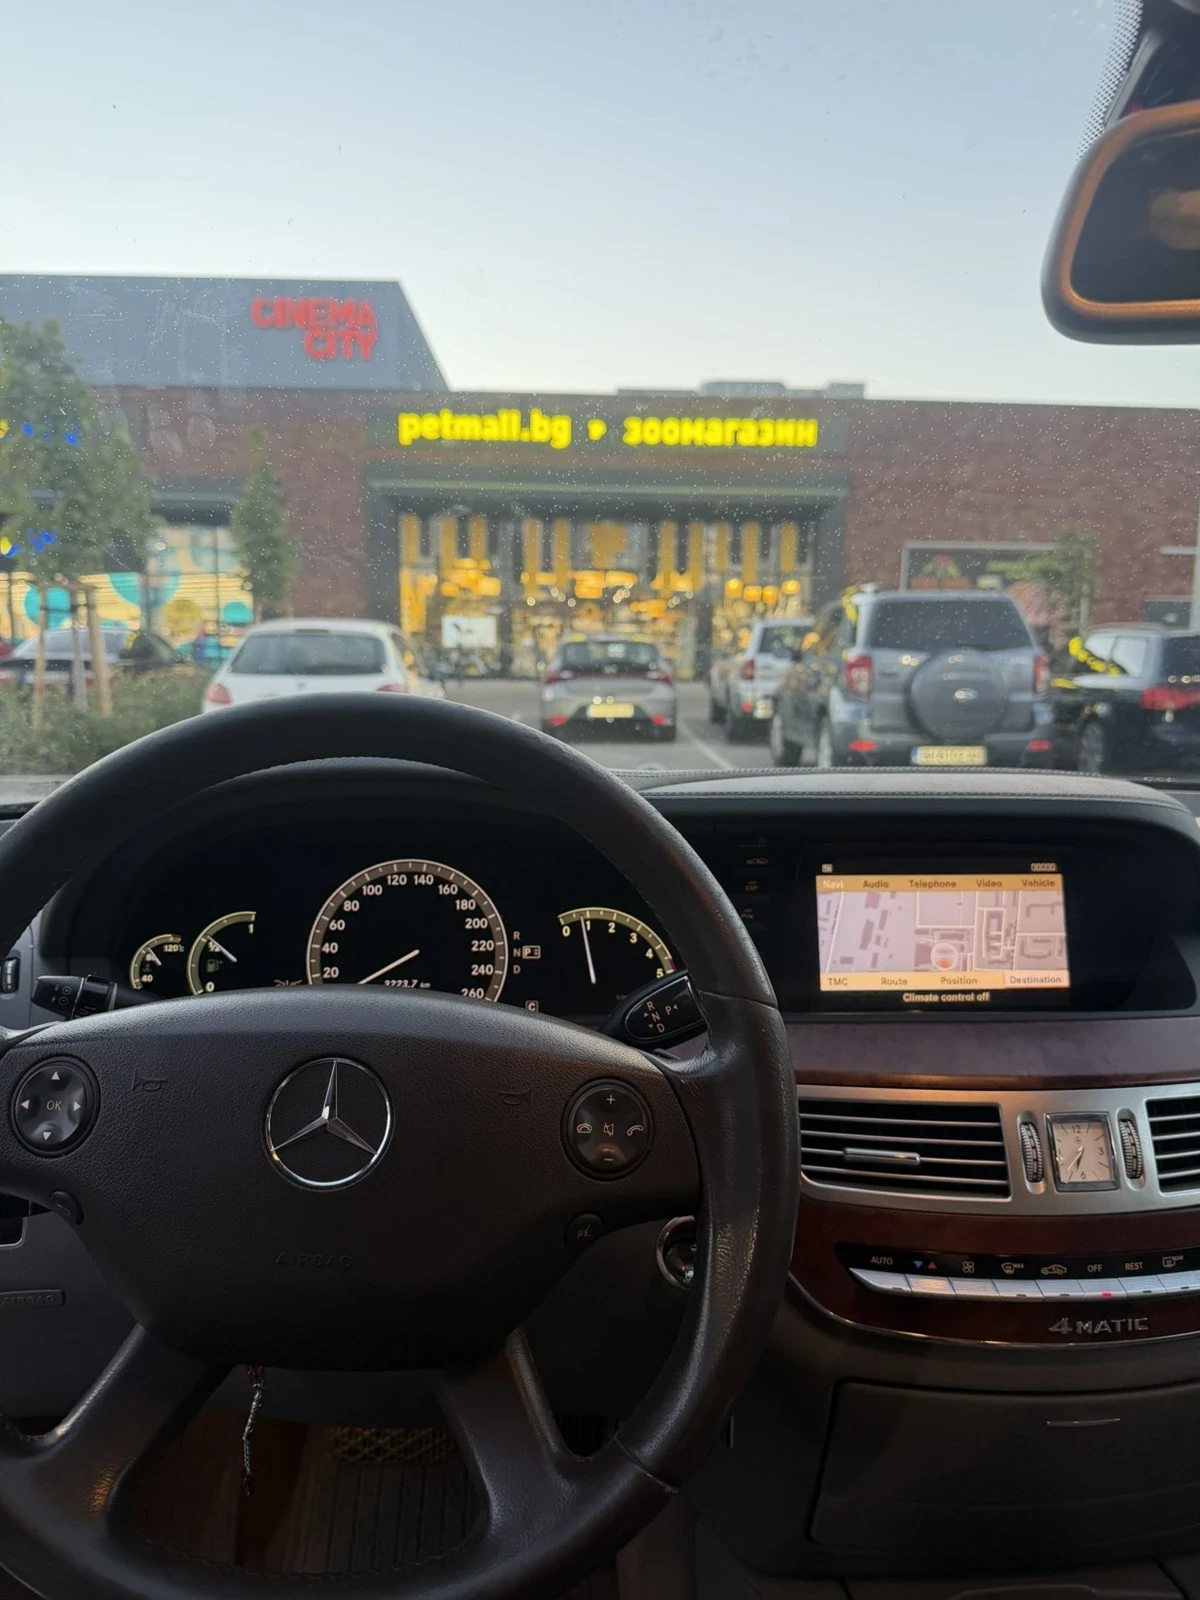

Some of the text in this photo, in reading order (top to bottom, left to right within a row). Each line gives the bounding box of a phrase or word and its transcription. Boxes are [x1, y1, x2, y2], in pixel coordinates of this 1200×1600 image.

[251, 296, 377, 328] CINEMA
[303, 327, 378, 361] CITY
[398, 407, 572, 449] petmall.bg
[622, 416, 818, 448] зоомагазин
[387, 874, 407, 886] 120
[413, 874, 434, 886] 140
[822, 878, 1056, 888] Navi Audio Telephone Video Vehicle
[362, 884, 383, 896] 100
[438, 884, 458, 896] 160
[343, 900, 360, 912] 80
[455, 899, 476, 911] 180
[248, 923, 254, 934] 1
[329, 919, 345, 931] 60
[464, 917, 488, 930] 200
[585, 920, 591, 931] 1
[608, 922, 616, 933] 2
[512, 931, 521, 941] R
[562, 926, 571, 937] 0
[630, 932, 638, 943] 3
[322, 942, 339, 954] 40
[471, 939, 494, 952] 220
[512, 948, 521, 958] N
[645, 947, 654, 959] 4
[322, 966, 339, 979] 20
[471, 964, 494, 976] 240
[512, 965, 521, 974] D
[656, 968, 664, 979] 5
[141, 974, 153, 983] 40
[827, 975, 1062, 987] TMC Route Position Destination
[205, 981, 215, 992] 0
[461, 988, 485, 999] 260
[902, 991, 991, 1003] Climate control off
[646, 1001, 655, 1011] R
[665, 1005, 672, 1015] P
[651, 1011, 661, 1022] N
[656, 1022, 665, 1033] D
[46, 1100, 62, 1111] OK
[1072, 1124, 1082, 1134] 12
[1098, 1147, 1104, 1156] 3
[1080, 1171, 1086, 1180] 6
[275, 1252, 353, 1269] AIRBAG
[870, 1256, 893, 1266] AUTO
[1125, 1261, 1143, 1271] REST
[1087, 1264, 1103, 1273] OFF
